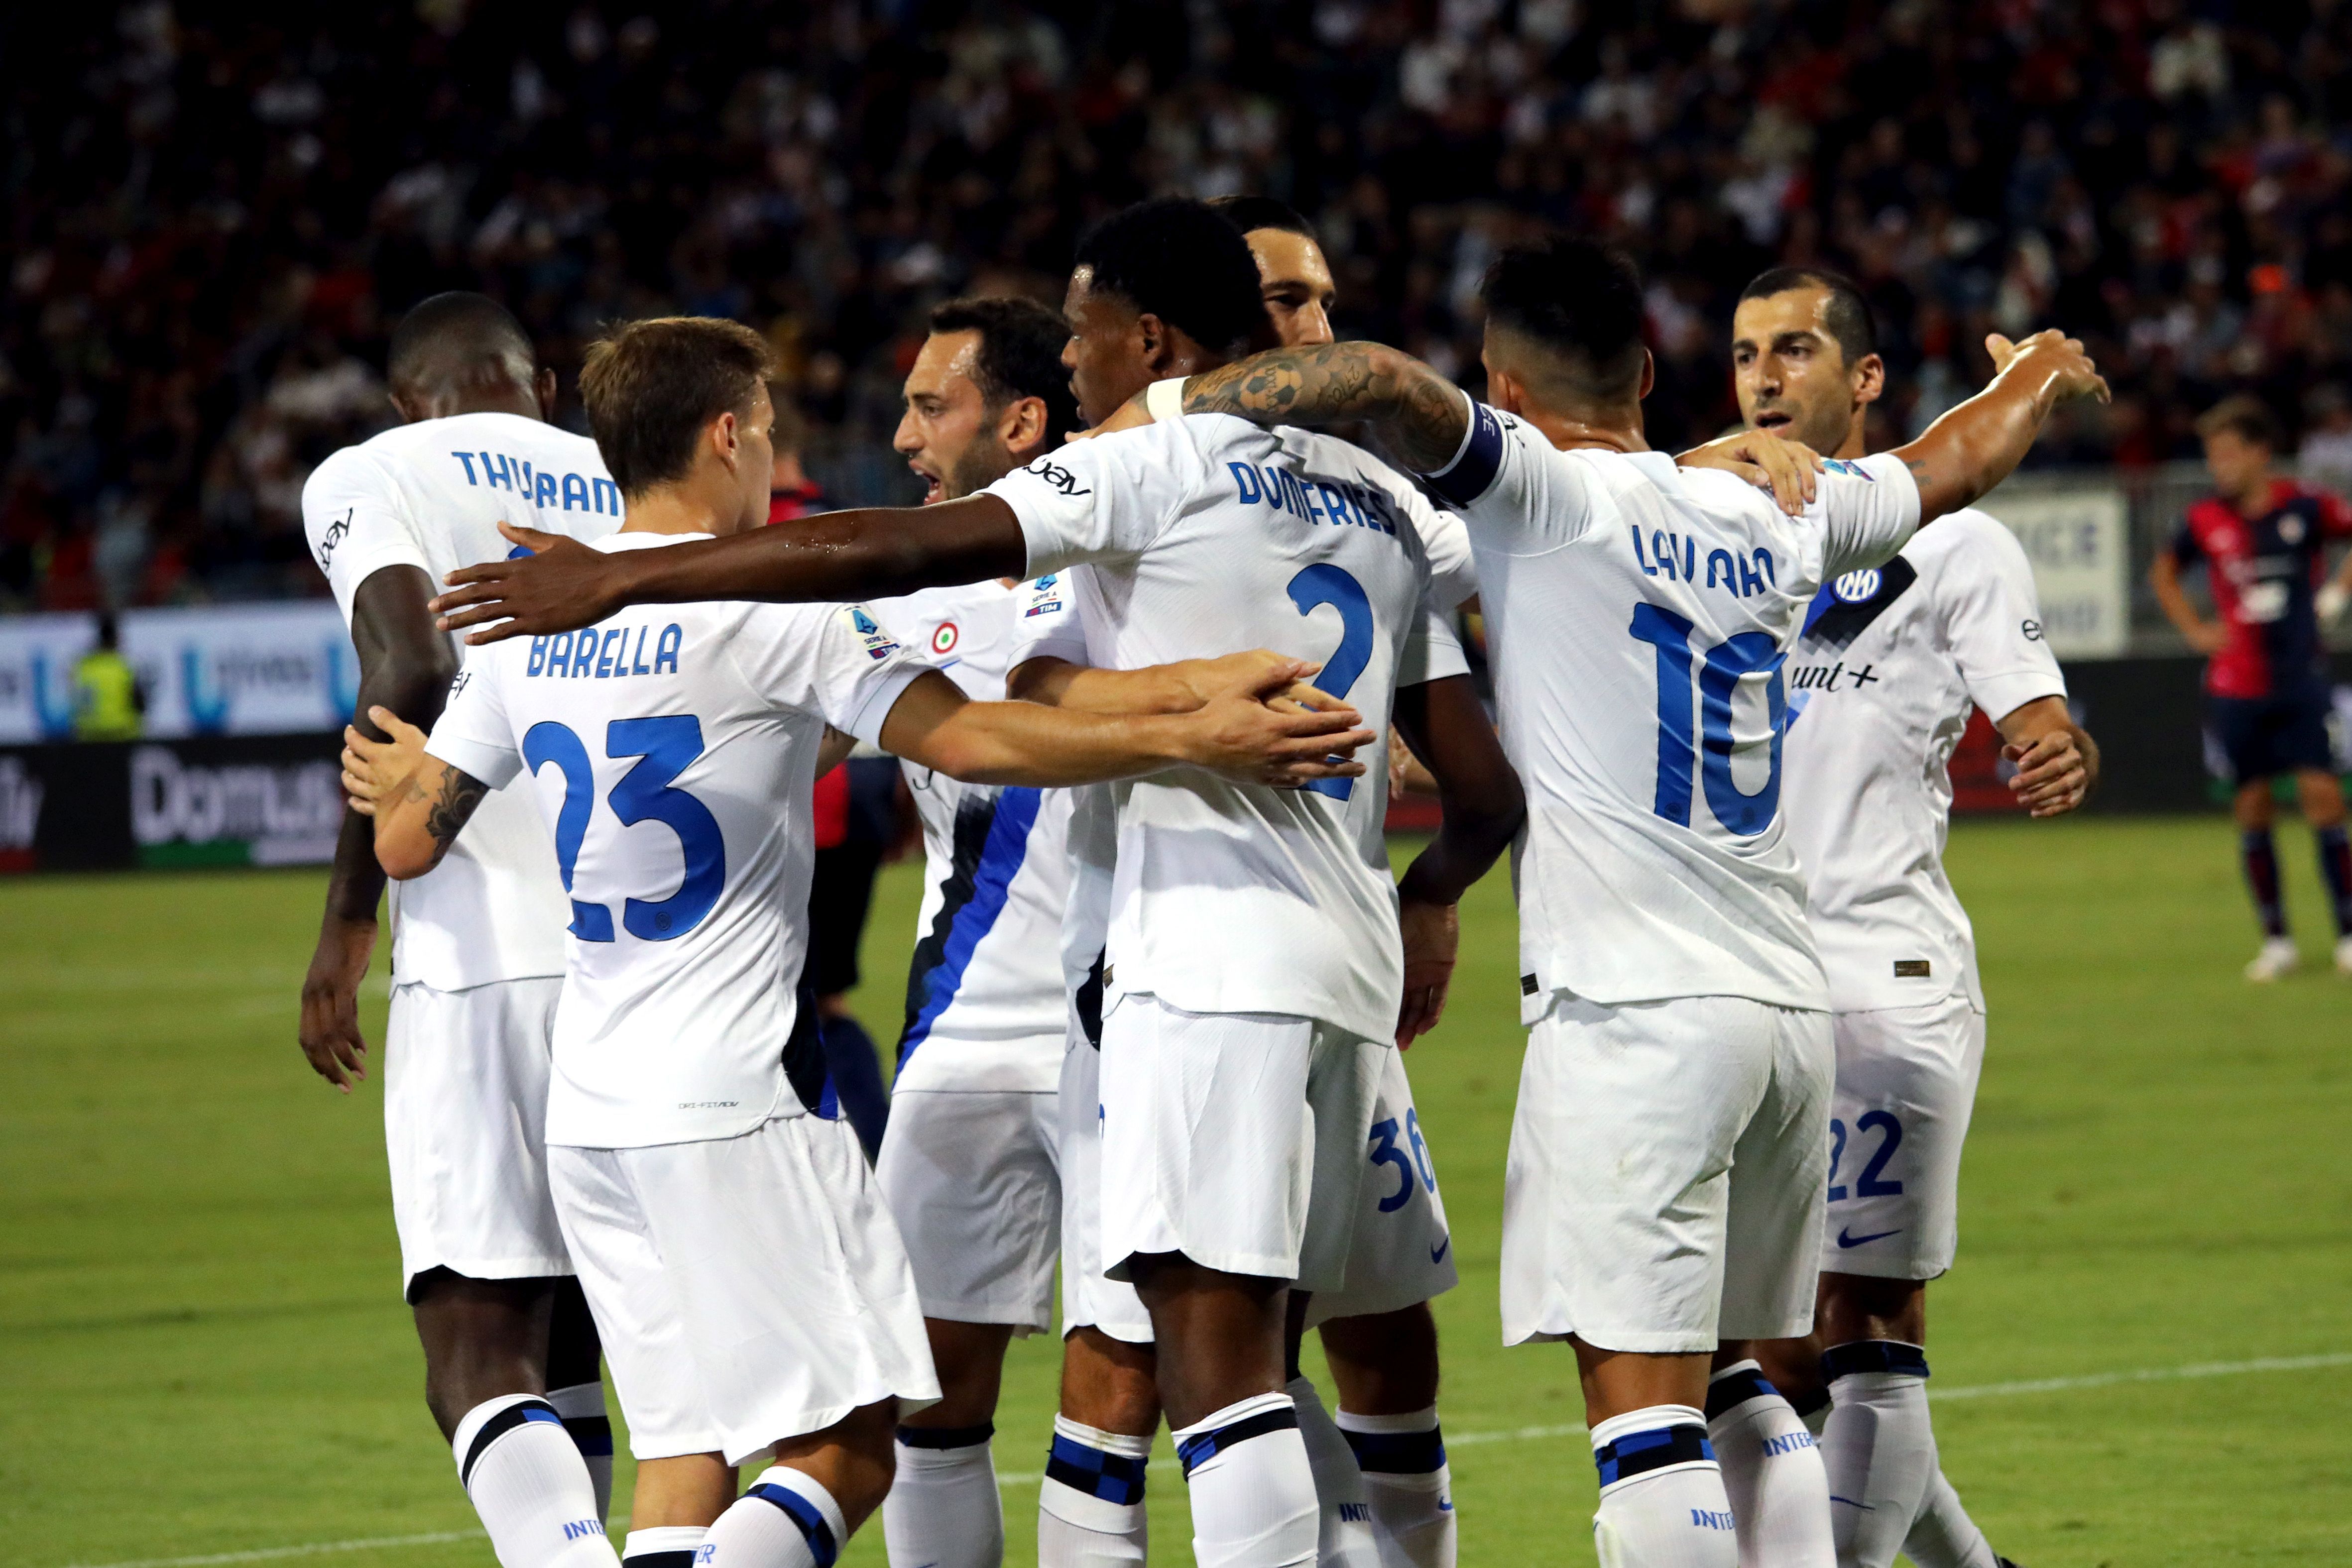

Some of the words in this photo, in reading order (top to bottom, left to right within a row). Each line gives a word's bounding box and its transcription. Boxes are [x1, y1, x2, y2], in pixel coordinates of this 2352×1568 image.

[1226, 461, 1396, 536] DUMFRIES
[526, 623, 683, 678] BARELLA
[1040, 604, 1058, 613] TIM
[1275, 562, 1373, 801] 2
[1629, 602, 1788, 836] 10
[522, 714, 725, 943] 23
[1369, 1107, 1434, 1213] 36
[1827, 1110, 1902, 1203] 22
